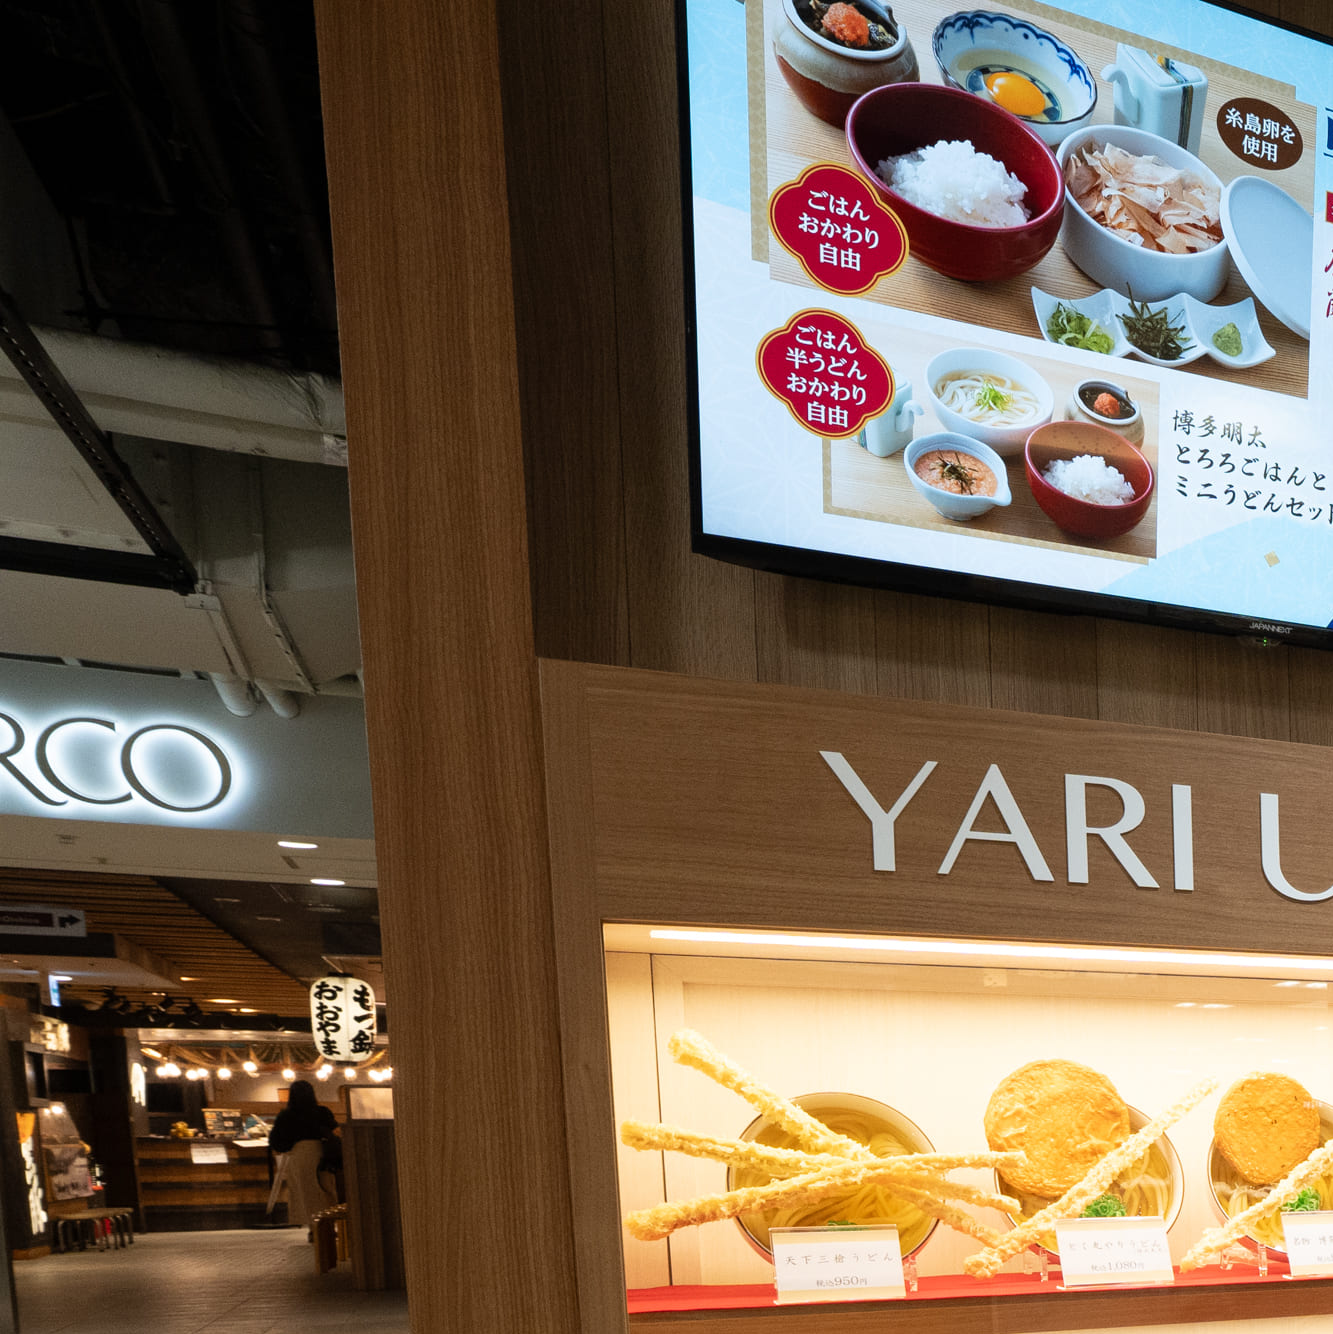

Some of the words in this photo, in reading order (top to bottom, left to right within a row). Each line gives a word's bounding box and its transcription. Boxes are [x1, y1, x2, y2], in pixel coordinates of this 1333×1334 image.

[1225, 107, 1295, 144] 糸島卵を
[1241, 135, 1278, 163] 使用
[807, 189, 870, 221] ごはん
[798, 212, 880, 248] おかわり
[819, 243, 861, 271] 自由
[794, 324, 857, 355] ごはん
[786, 347, 867, 380] 半うどん
[786, 373, 867, 406] おかわり
[806, 401, 849, 428] 自由
[1172, 409, 1268, 449] 博多明太
[1175, 443, 1328, 491] とろろごはんと
[1249, 622, 1294, 634] JAPANNEXT
[818, 749, 1196, 893] YARI
[313, 981, 343, 1058] おおやま
[816, 1276, 868, 1288] 税込950円
